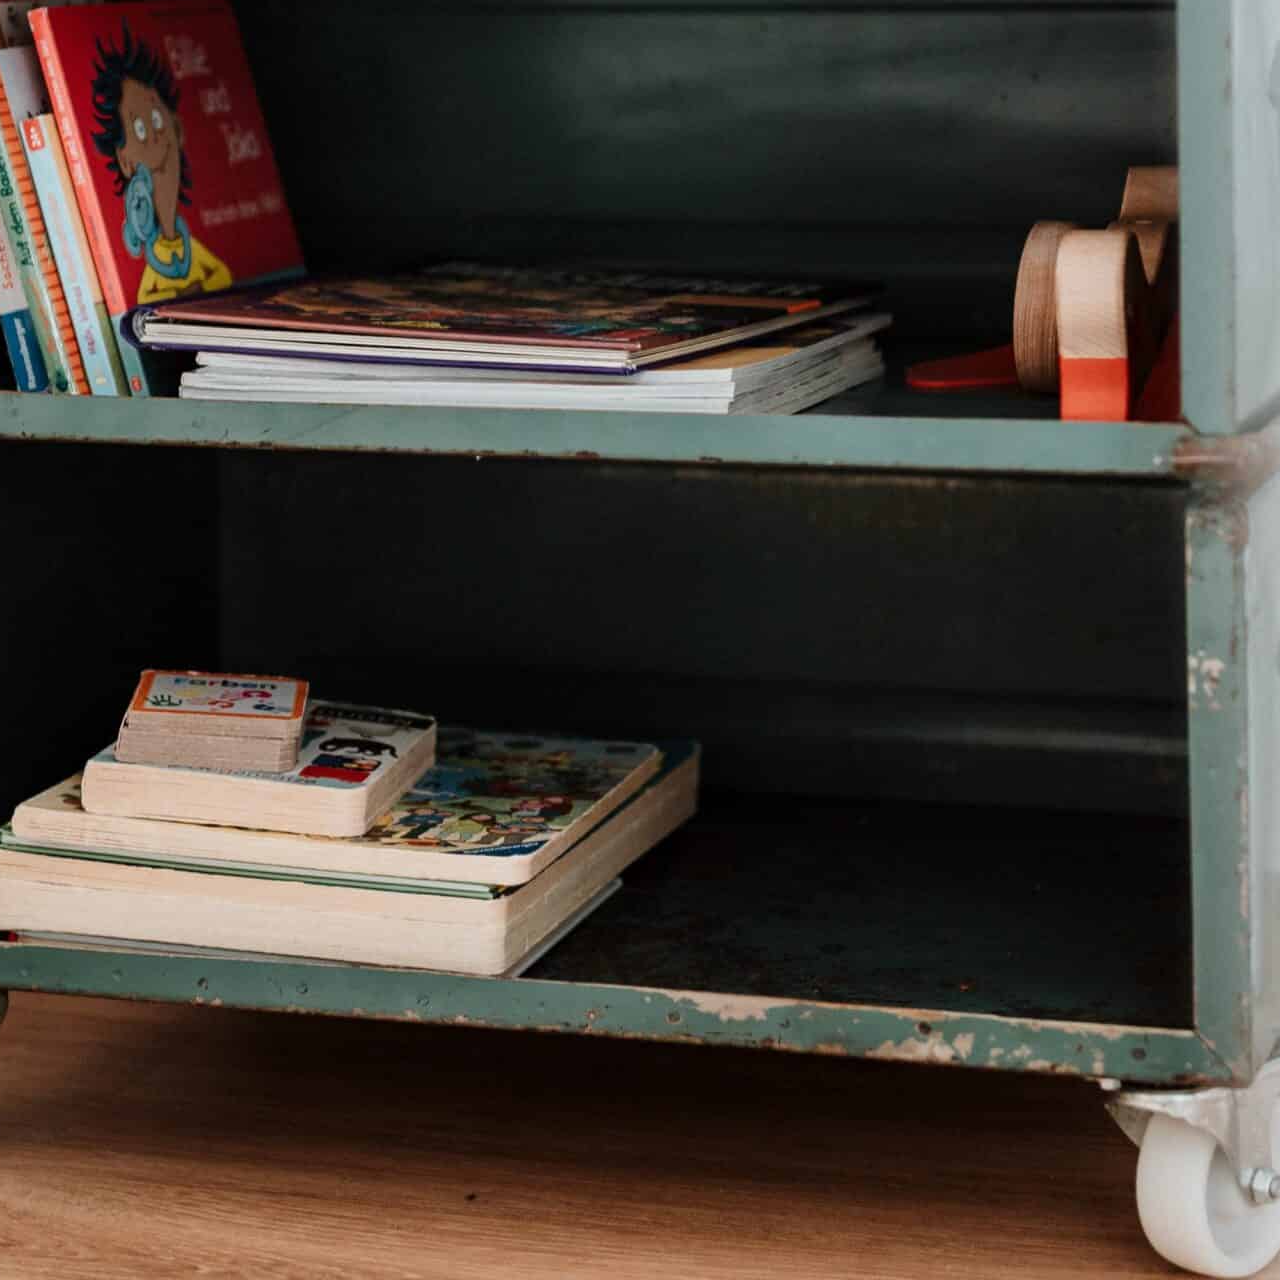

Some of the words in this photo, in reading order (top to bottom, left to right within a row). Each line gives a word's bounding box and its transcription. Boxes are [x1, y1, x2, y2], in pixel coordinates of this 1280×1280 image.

[4, 201, 24, 236] dem
[15, 240, 33, 268] Auf
[173, 677, 277, 690] Farben
